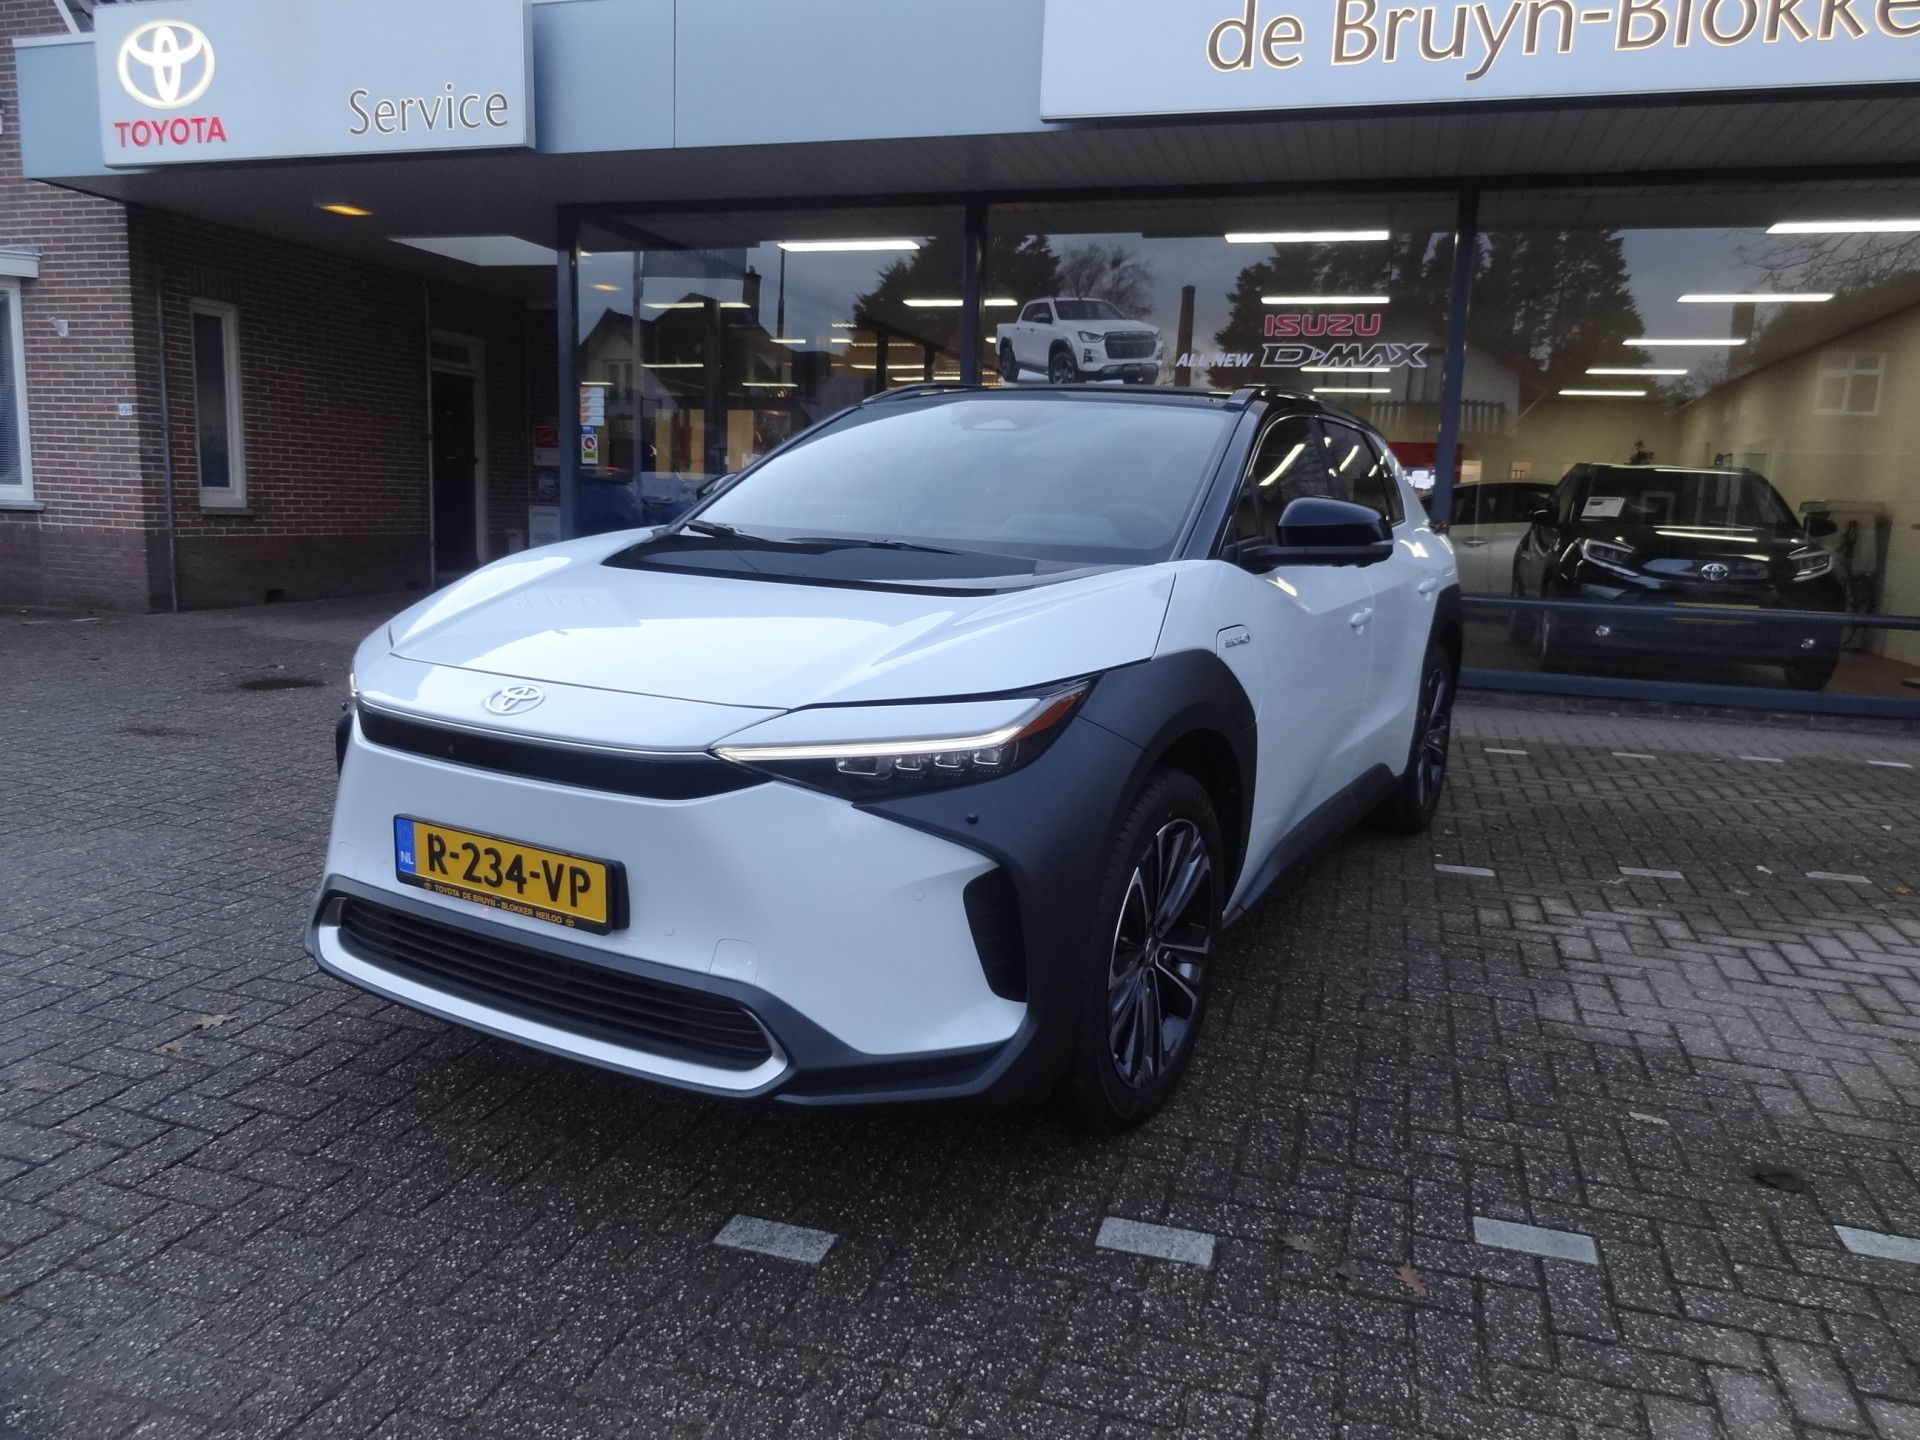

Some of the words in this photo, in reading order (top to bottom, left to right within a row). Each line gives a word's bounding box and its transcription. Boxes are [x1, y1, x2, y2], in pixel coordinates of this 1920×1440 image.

[1206, 0, 1304, 72] de
[348, 82, 509, 135] Service
[114, 117, 228, 148] TOYOTA
[1264, 313, 1381, 337] ISUZU
[1176, 353, 1207, 368] ALL
[1209, 353, 1254, 368] NEW
[400, 851, 415, 866] NL
[427, 833, 591, 908] R-234-VP
[435, 884, 460, 897] TOYOTA
[462, 891, 472, 901] DE
[472, 894, 496, 907] BRUYN
[501, 901, 534, 916] BLOKKER
[536, 910, 562, 924] HEILOO
